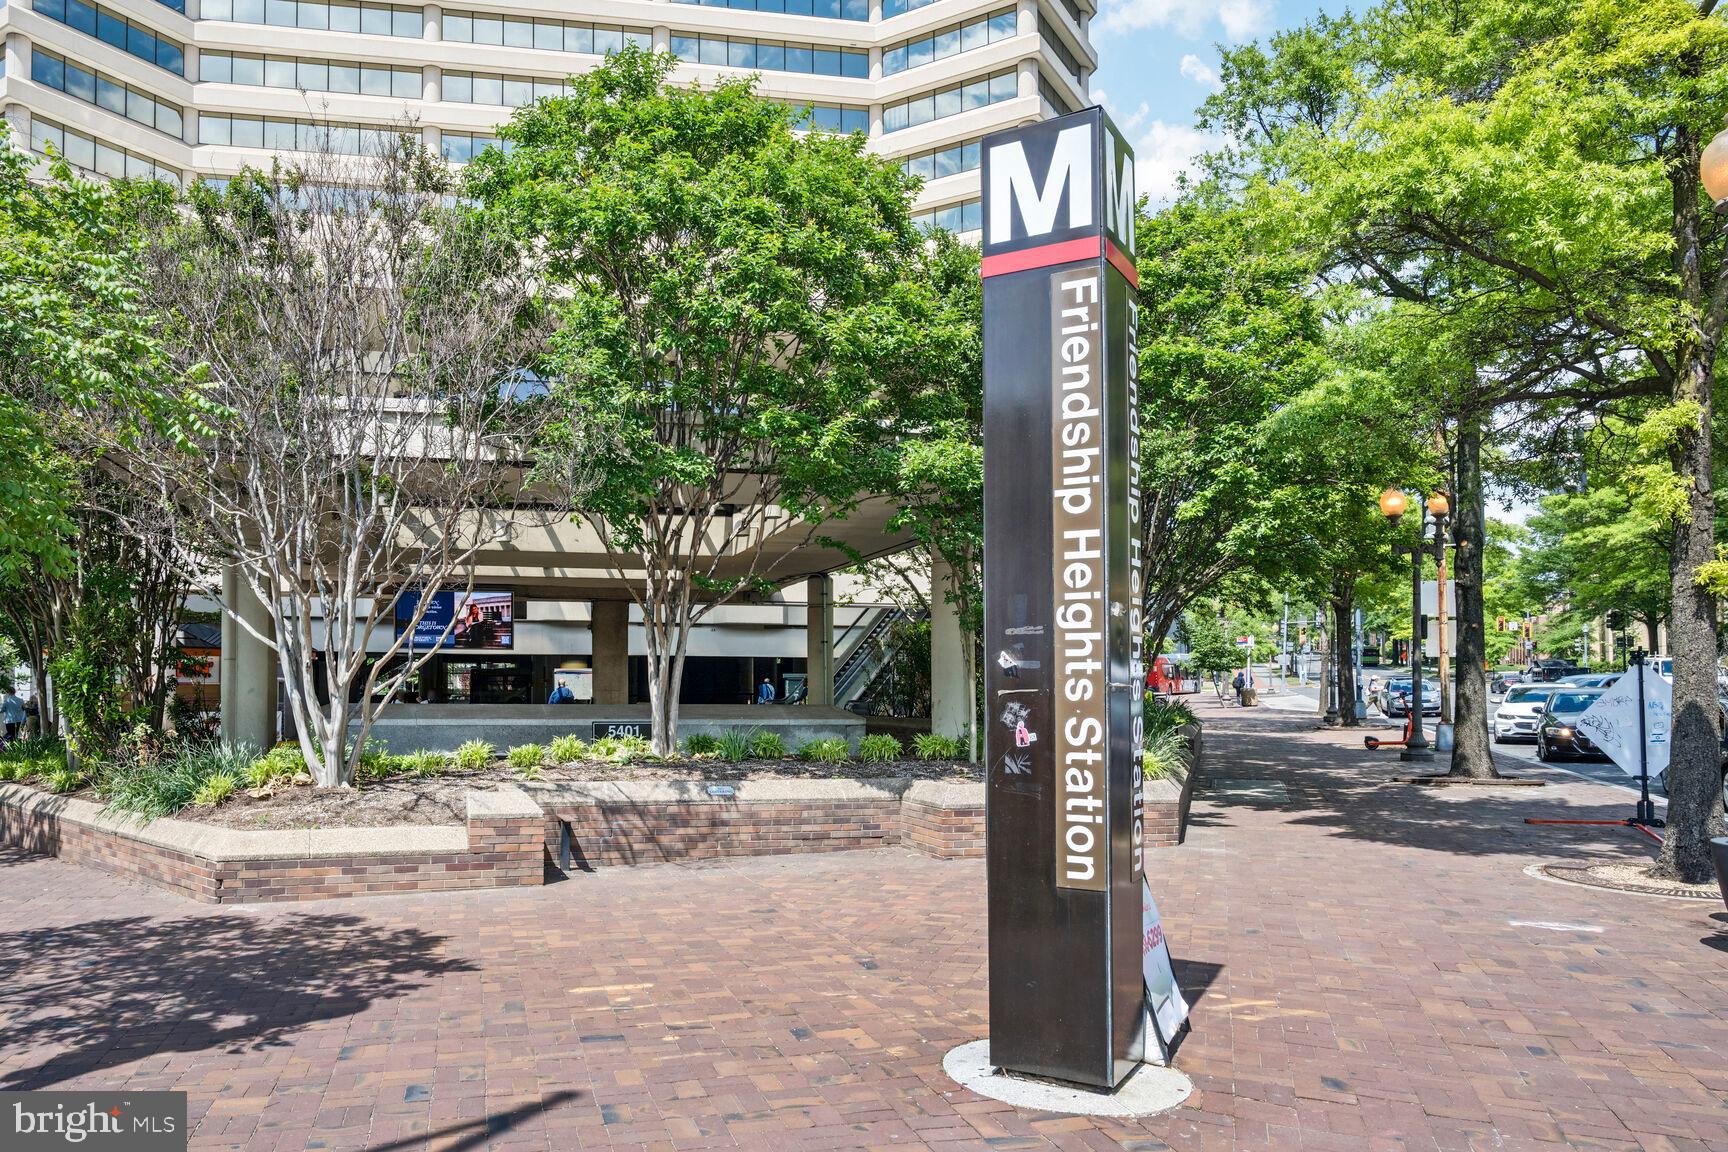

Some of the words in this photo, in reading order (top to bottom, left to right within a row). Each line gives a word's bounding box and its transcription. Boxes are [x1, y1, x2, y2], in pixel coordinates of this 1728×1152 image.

[989, 123, 1092, 245] M
[1104, 126, 1135, 256] M
[1054, 277, 1100, 515] Friendship
[1128, 299, 1141, 525] Friendship
[1056, 529, 1102, 702] Heights
[608, 725, 640, 738] 5401
[1063, 717, 1103, 882] Station
[1132, 715, 1144, 872] Station
